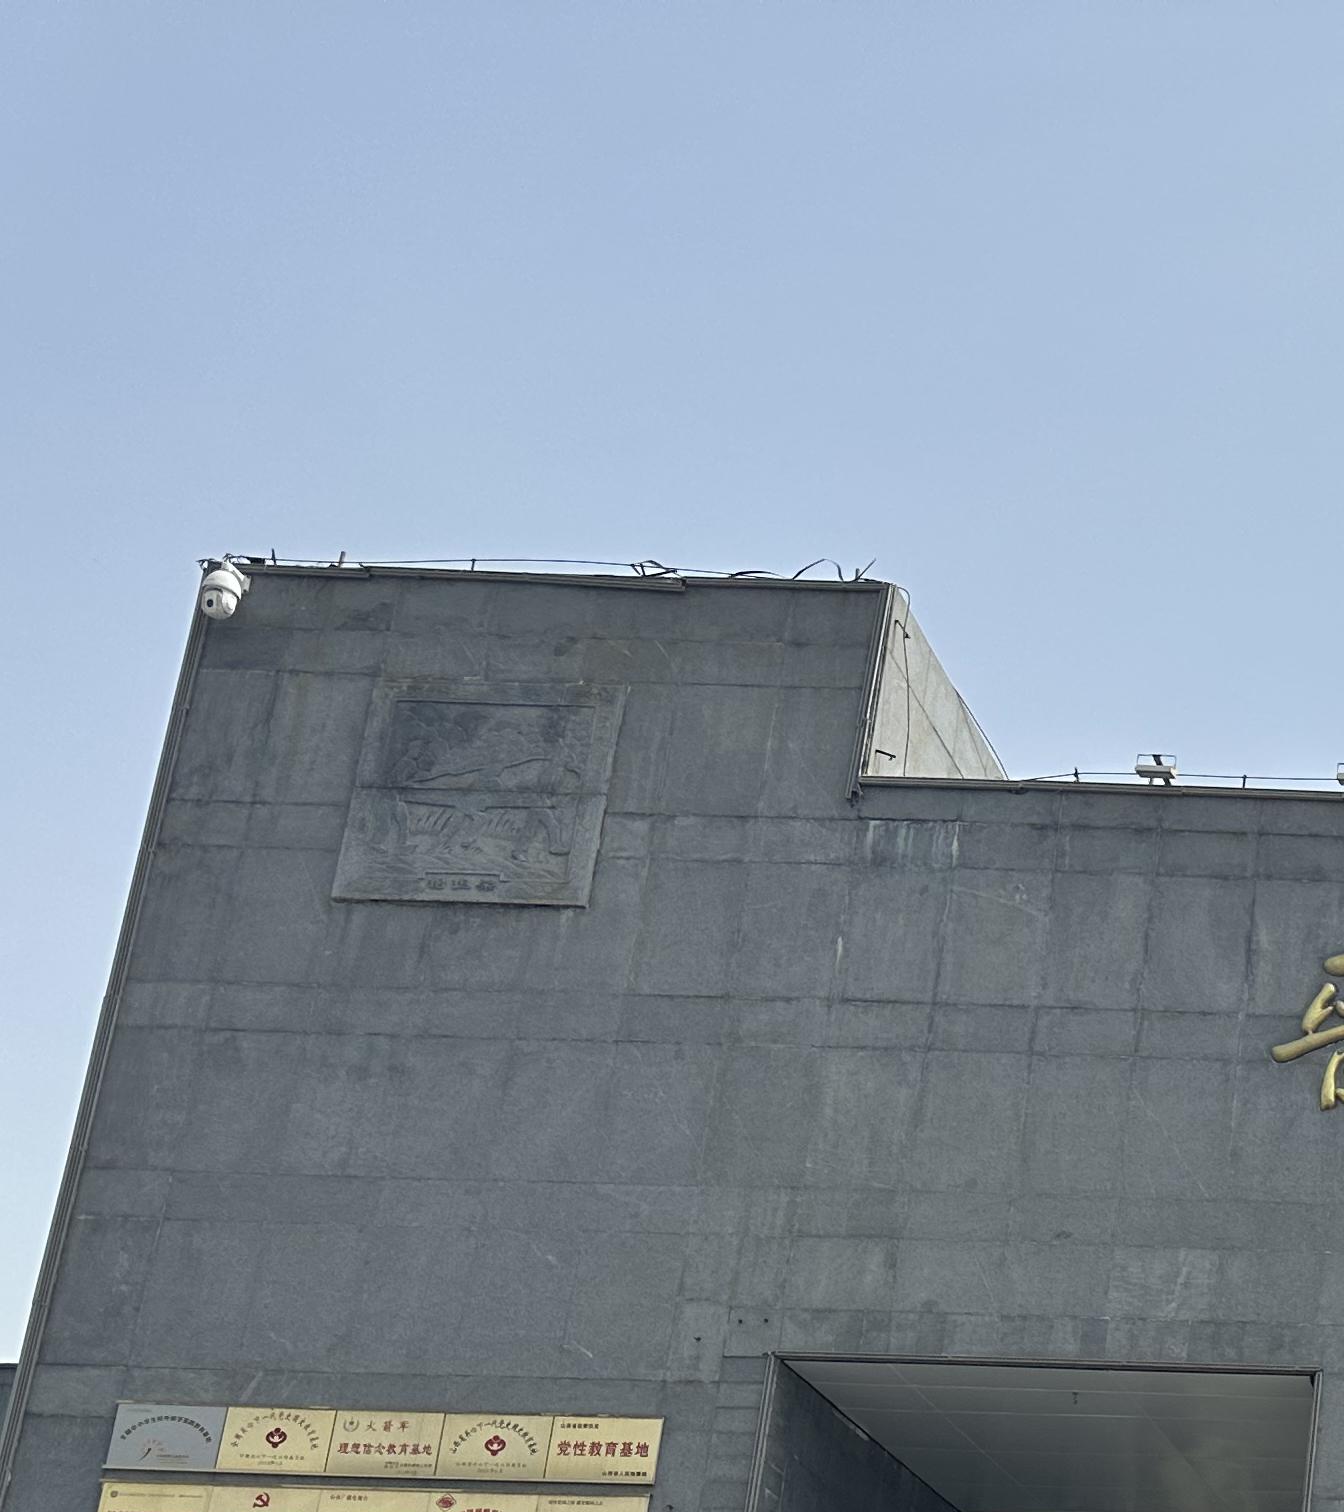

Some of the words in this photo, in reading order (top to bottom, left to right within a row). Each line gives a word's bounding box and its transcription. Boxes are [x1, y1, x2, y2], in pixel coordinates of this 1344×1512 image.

[337, 1442, 433, 1456] 理想信念教育基地
[557, 1441, 649, 1458] 党性教育基地
